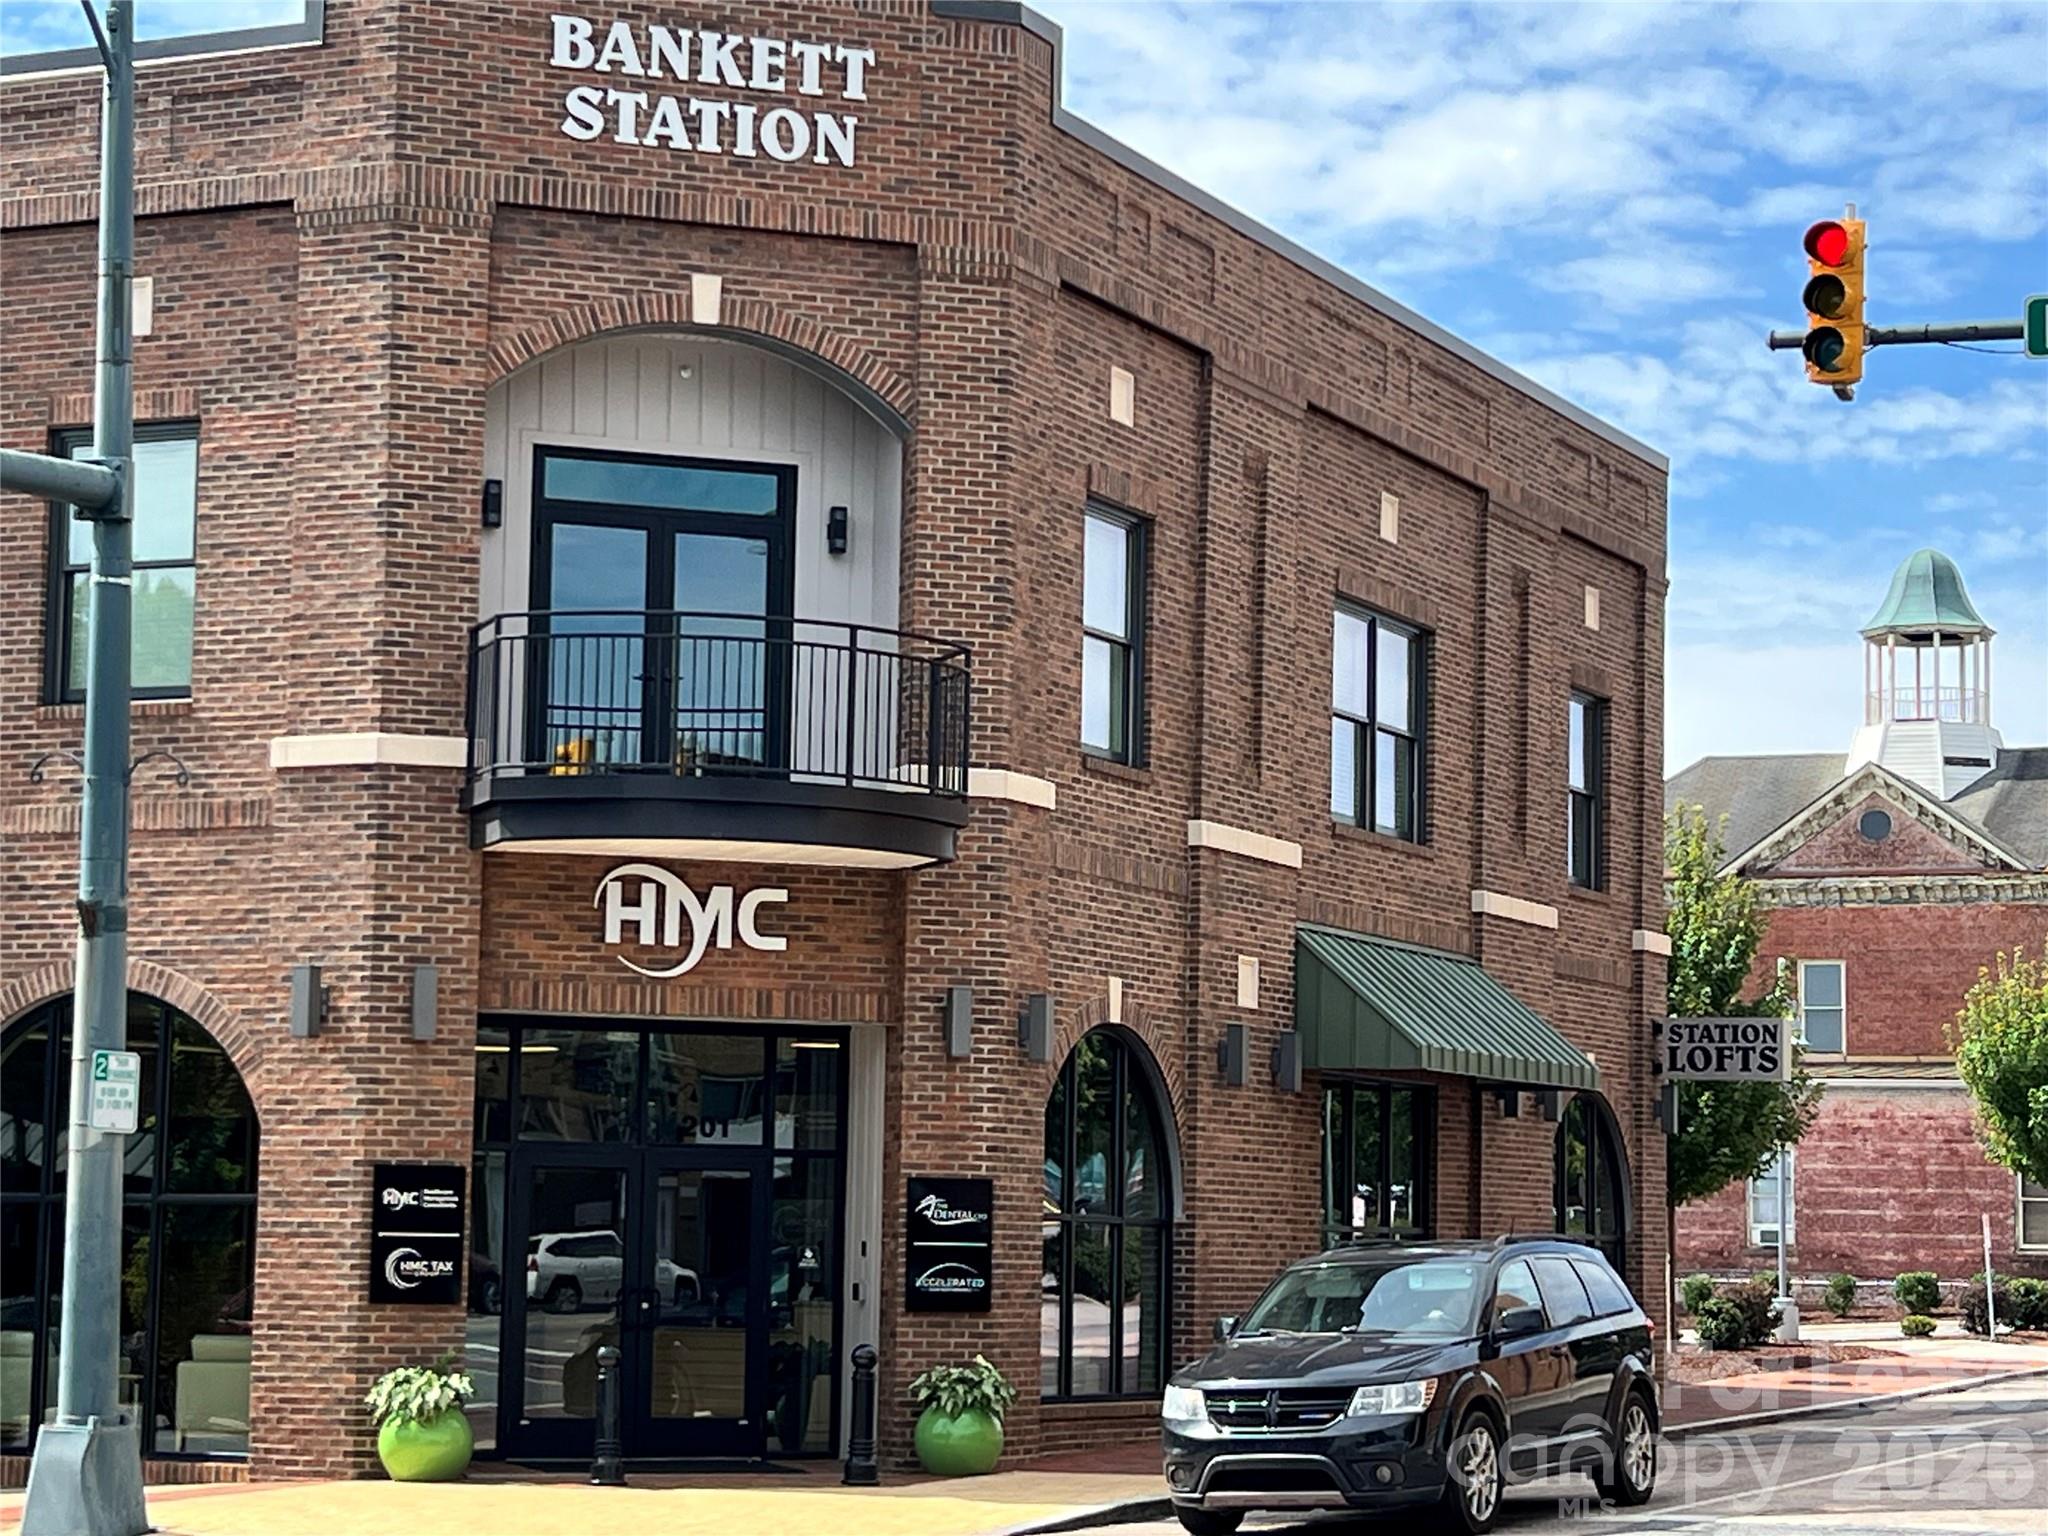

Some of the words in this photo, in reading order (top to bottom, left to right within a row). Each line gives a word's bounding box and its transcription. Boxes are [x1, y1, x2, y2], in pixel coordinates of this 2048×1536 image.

[550, 14, 875, 100] BANKETT
[561, 86, 858, 167] STATION
[594, 863, 789, 978] HMC
[1667, 1023, 1778, 1044] STATION
[96, 1057, 107, 1078] 2
[1667, 1046, 1778, 1073] LOFTS
[677, 1116, 729, 1138] 201
[933, 1209, 972, 1219] DENTAL
[430, 1261, 453, 1271] TAX
